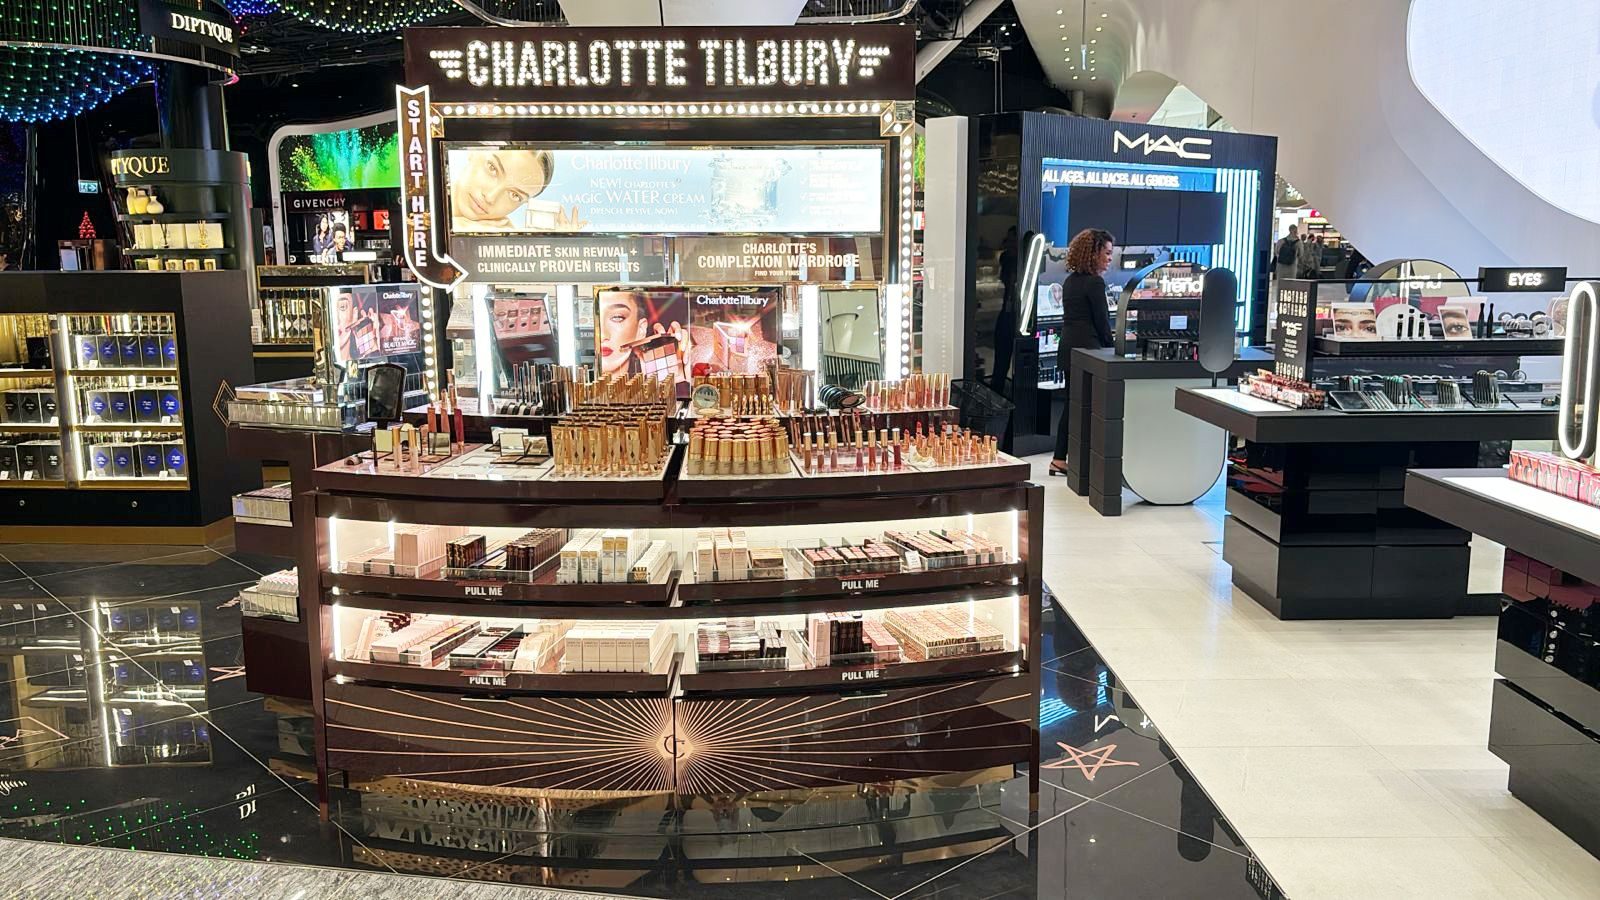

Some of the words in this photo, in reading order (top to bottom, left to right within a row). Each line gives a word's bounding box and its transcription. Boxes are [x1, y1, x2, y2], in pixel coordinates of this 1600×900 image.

[171, 12, 233, 43] DIPTYQUE
[466, 39, 687, 87] CHARLOTTE
[697, 38, 857, 87] TILBURY
[407, 99, 424, 189] START
[1042, 170, 1060, 183] ALL
[1086, 171, 1102, 185] ALL
[1131, 173, 1145, 186] ALL
[293, 197, 346, 208] GIVENCHY
[606, 190, 660, 204] WATER
[663, 193, 705, 204] CREAM
[411, 195, 428, 268] HERE
[478, 245, 551, 258] IMMEDIATE
[554, 246, 580, 258] SKIN
[583, 246, 626, 258] REVIVAL
[742, 243, 817, 254] CHARLOTTE'S
[477, 262, 536, 273] CLINICALLY
[539, 260, 592, 273] PROVEN
[594, 262, 640, 273] RESULTS
[697, 254, 785, 268] COMPLEXION
[786, 254, 860, 268] WARDROBE
[1508, 272, 1542, 286] EYES
[465, 586, 487, 596] PULL
[488, 587, 503, 596] ME
[841, 580, 863, 590] PULL
[865, 579, 879, 589] ME
[469, 676, 491, 685] PULL
[492, 677, 506, 686] ME
[841, 671, 863, 681] PULL
[865, 669, 879, 679] ME
